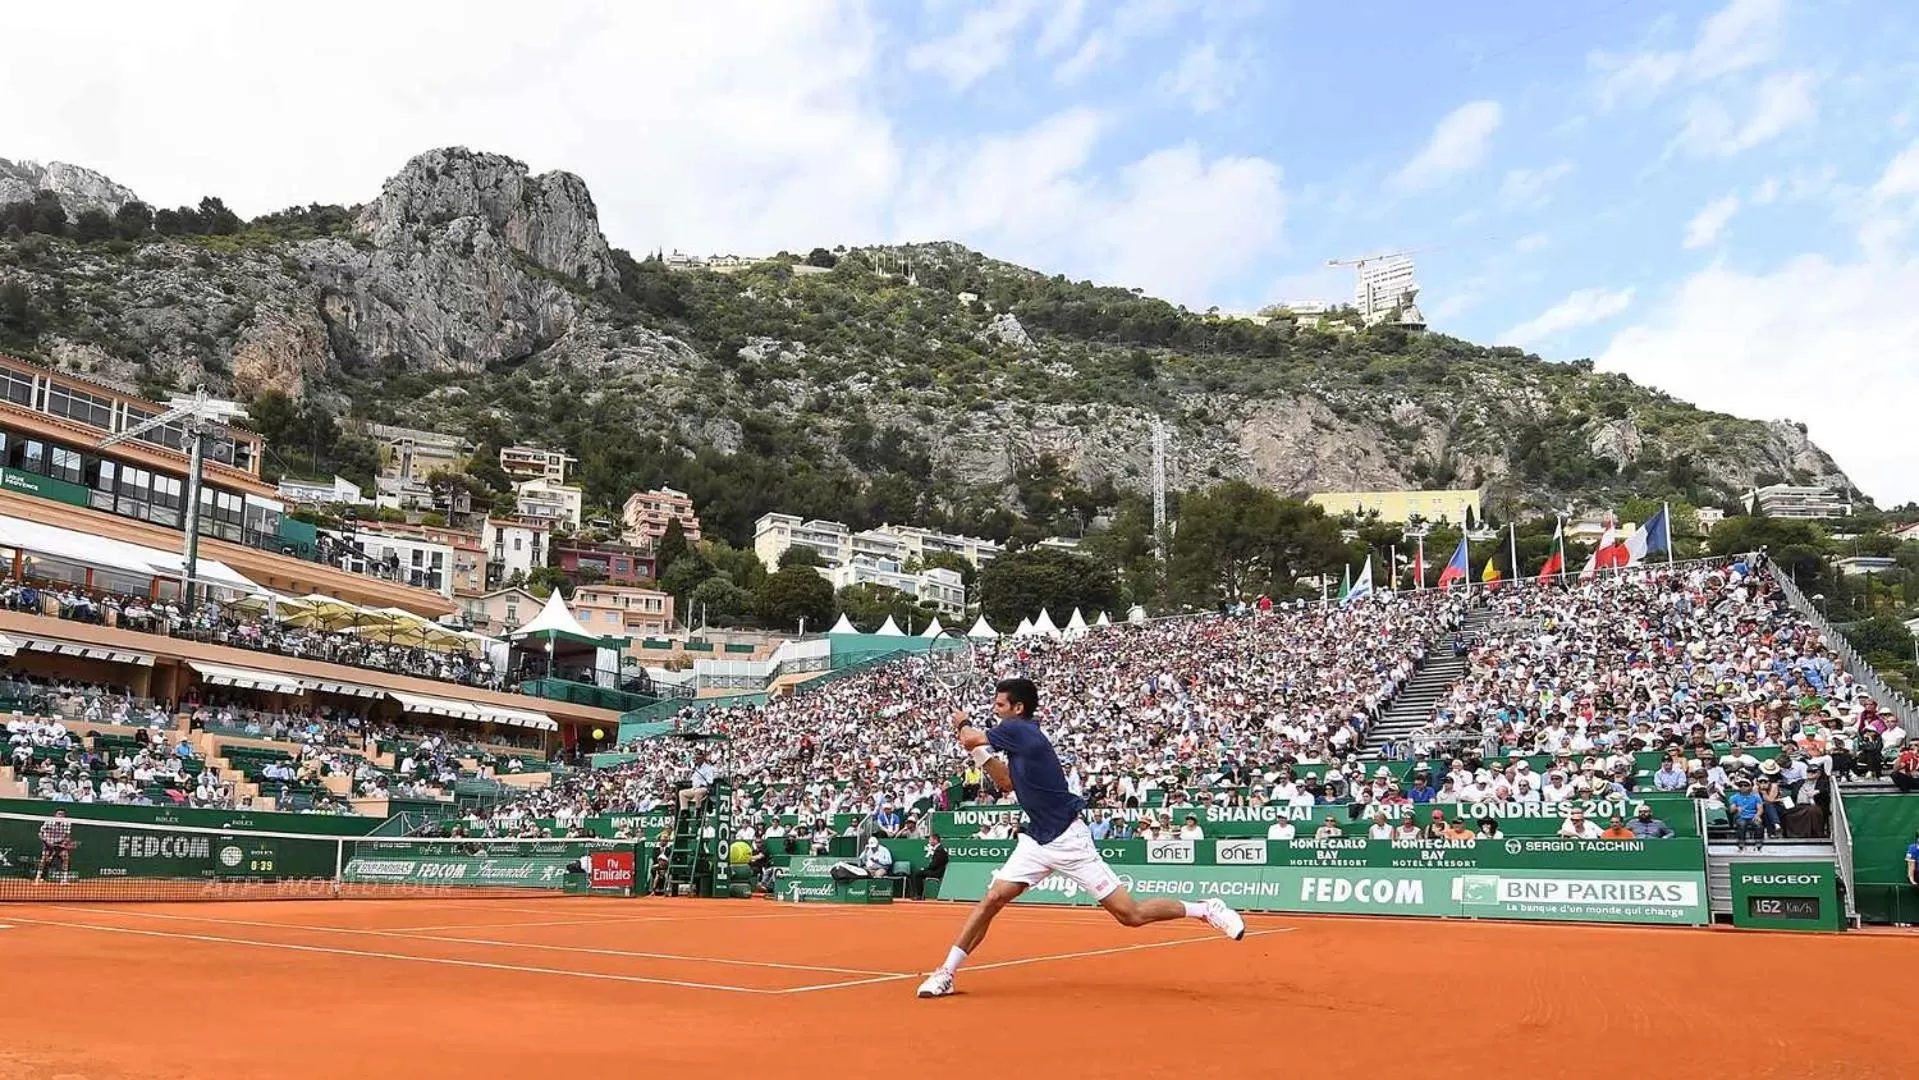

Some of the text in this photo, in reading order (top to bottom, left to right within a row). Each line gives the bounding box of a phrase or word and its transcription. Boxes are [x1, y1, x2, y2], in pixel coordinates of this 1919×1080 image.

[1206, 806, 1312, 821] SHANGHAI
[1457, 800, 1645, 819] LONDRES 2017
[717, 795, 730, 880] RICOH
[118, 836, 210, 858] FEDCOM
[944, 847, 1010, 857] EUGEOT
[1525, 841, 1644, 852] SERGIO TACCHINI
[1317, 850, 1338, 860] BAY
[1421, 850, 1445, 860] BAY
[417, 863, 467, 879] FEDCOM
[593, 868, 631, 880] Emirates
[1742, 874, 1822, 884] PEUGEOT
[1136, 879, 1280, 896] SERGIO TACCHINI
[1301, 877, 1424, 905] FEDCOM
[1507, 882, 1683, 902] BNP PARIBAS
[1506, 903, 1684, 918] La banque d'un monde qui change
[1755, 899, 1781, 913] 162
